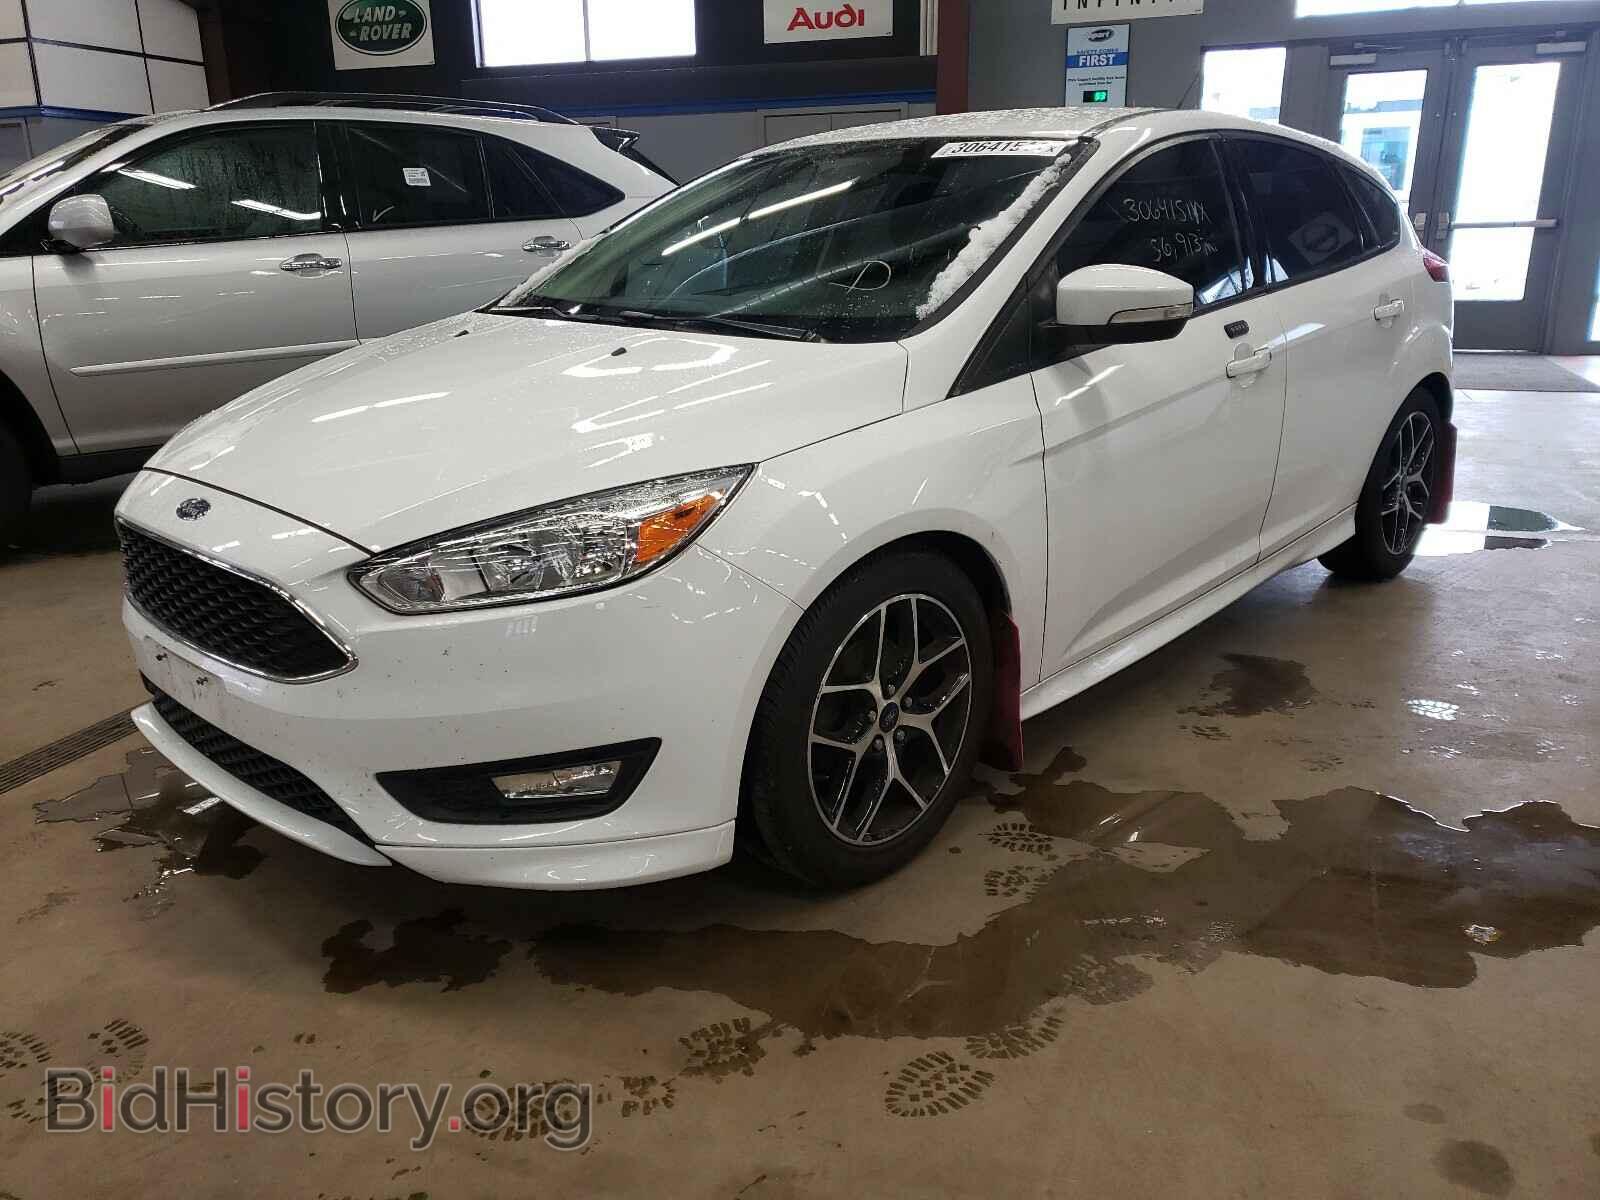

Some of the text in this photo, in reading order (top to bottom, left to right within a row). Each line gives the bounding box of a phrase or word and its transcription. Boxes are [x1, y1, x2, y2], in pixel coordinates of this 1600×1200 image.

[353, 5, 396, 23] LAND
[786, 3, 865, 31] Audi
[360, 24, 412, 41] ROVER
[1079, 53, 1116, 67] FIRST
